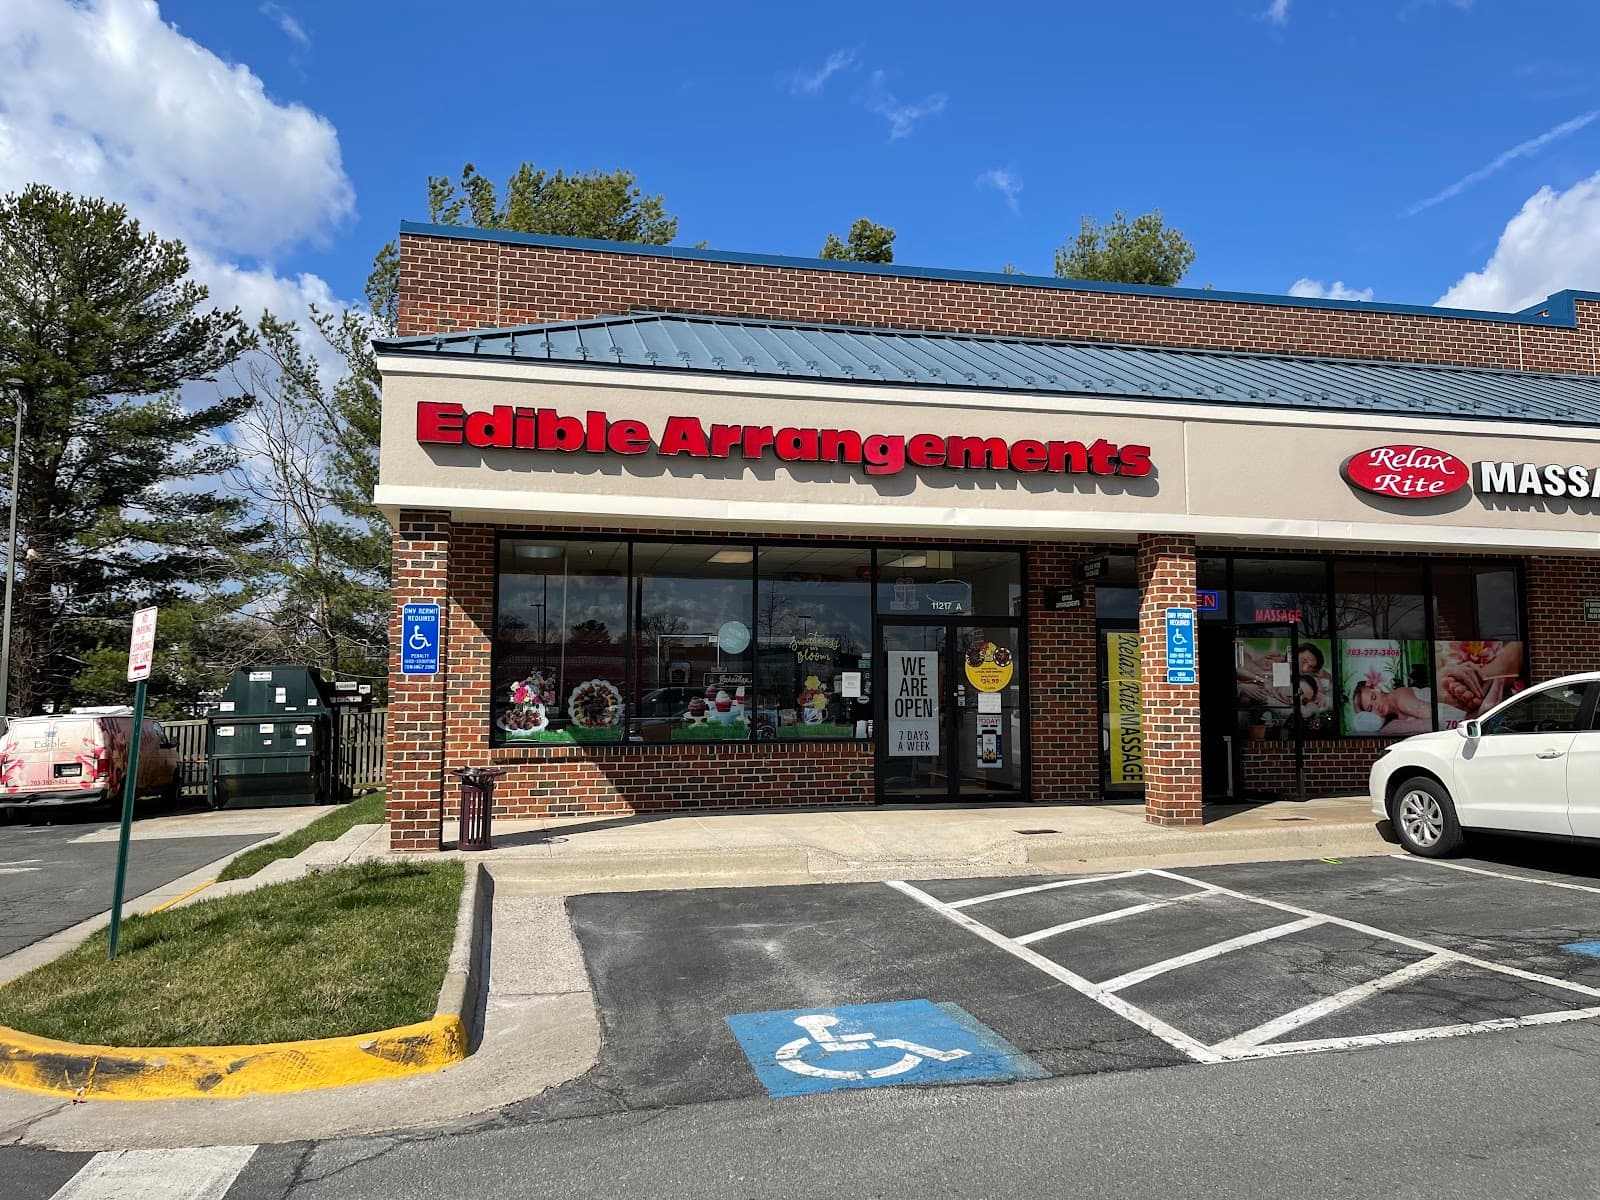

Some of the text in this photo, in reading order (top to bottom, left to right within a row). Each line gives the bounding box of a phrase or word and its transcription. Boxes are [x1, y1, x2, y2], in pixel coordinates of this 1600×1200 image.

[417, 401, 1152, 476] Edible Arrangements
[1368, 447, 1455, 475] Relax
[1373, 474, 1445, 496] Rite
[1196, 594, 1216, 608] EN
[1255, 608, 1301, 622] MASSAGE
[797, 650, 831, 664] Bloom
[901, 657, 926, 676] WE
[1118, 634, 1142, 680] Relax
[899, 677, 928, 697] ARE
[894, 698, 933, 718] OPEN
[1118, 681, 1144, 782] Rite MASSAGE
[1445, 720, 1459, 729] 70
[899, 730, 929, 740] 7 DAYS
[898, 741, 931, 751] A WEEK
